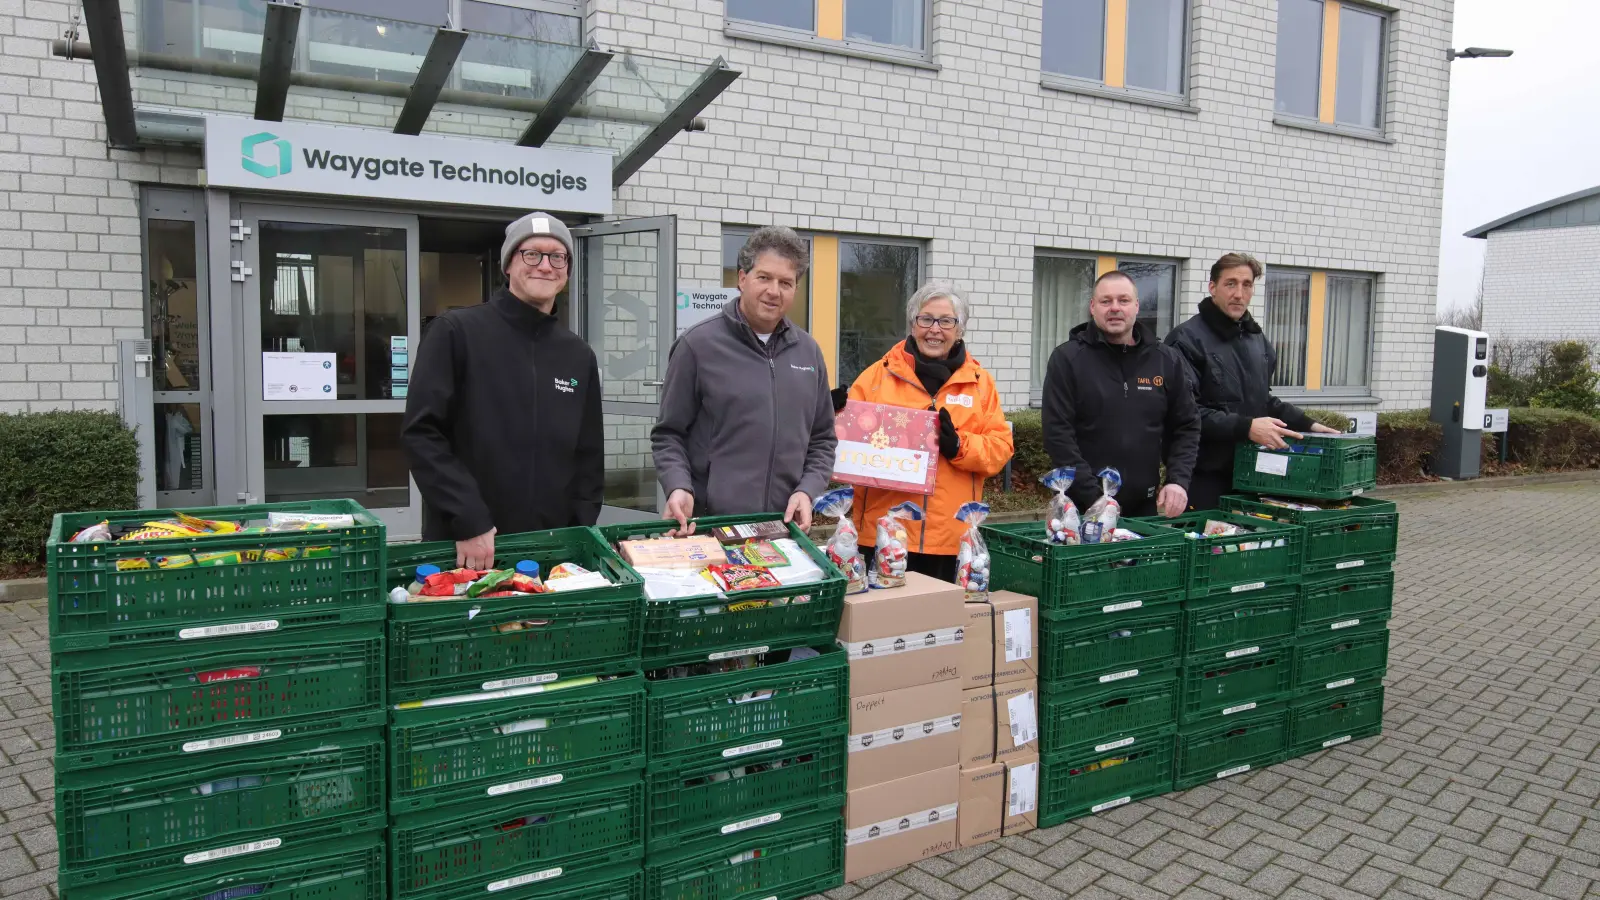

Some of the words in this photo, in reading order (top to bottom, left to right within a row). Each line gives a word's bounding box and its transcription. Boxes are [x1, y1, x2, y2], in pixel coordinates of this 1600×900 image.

[302, 148, 425, 180] Waygate
[428, 159, 588, 195] Technologies
[692, 293, 728, 302] Waygate
[692, 302, 723, 310] Technol
[554, 377, 570, 386] Baker
[555, 384, 574, 393] Hughes
[838, 449, 920, 474] merci
